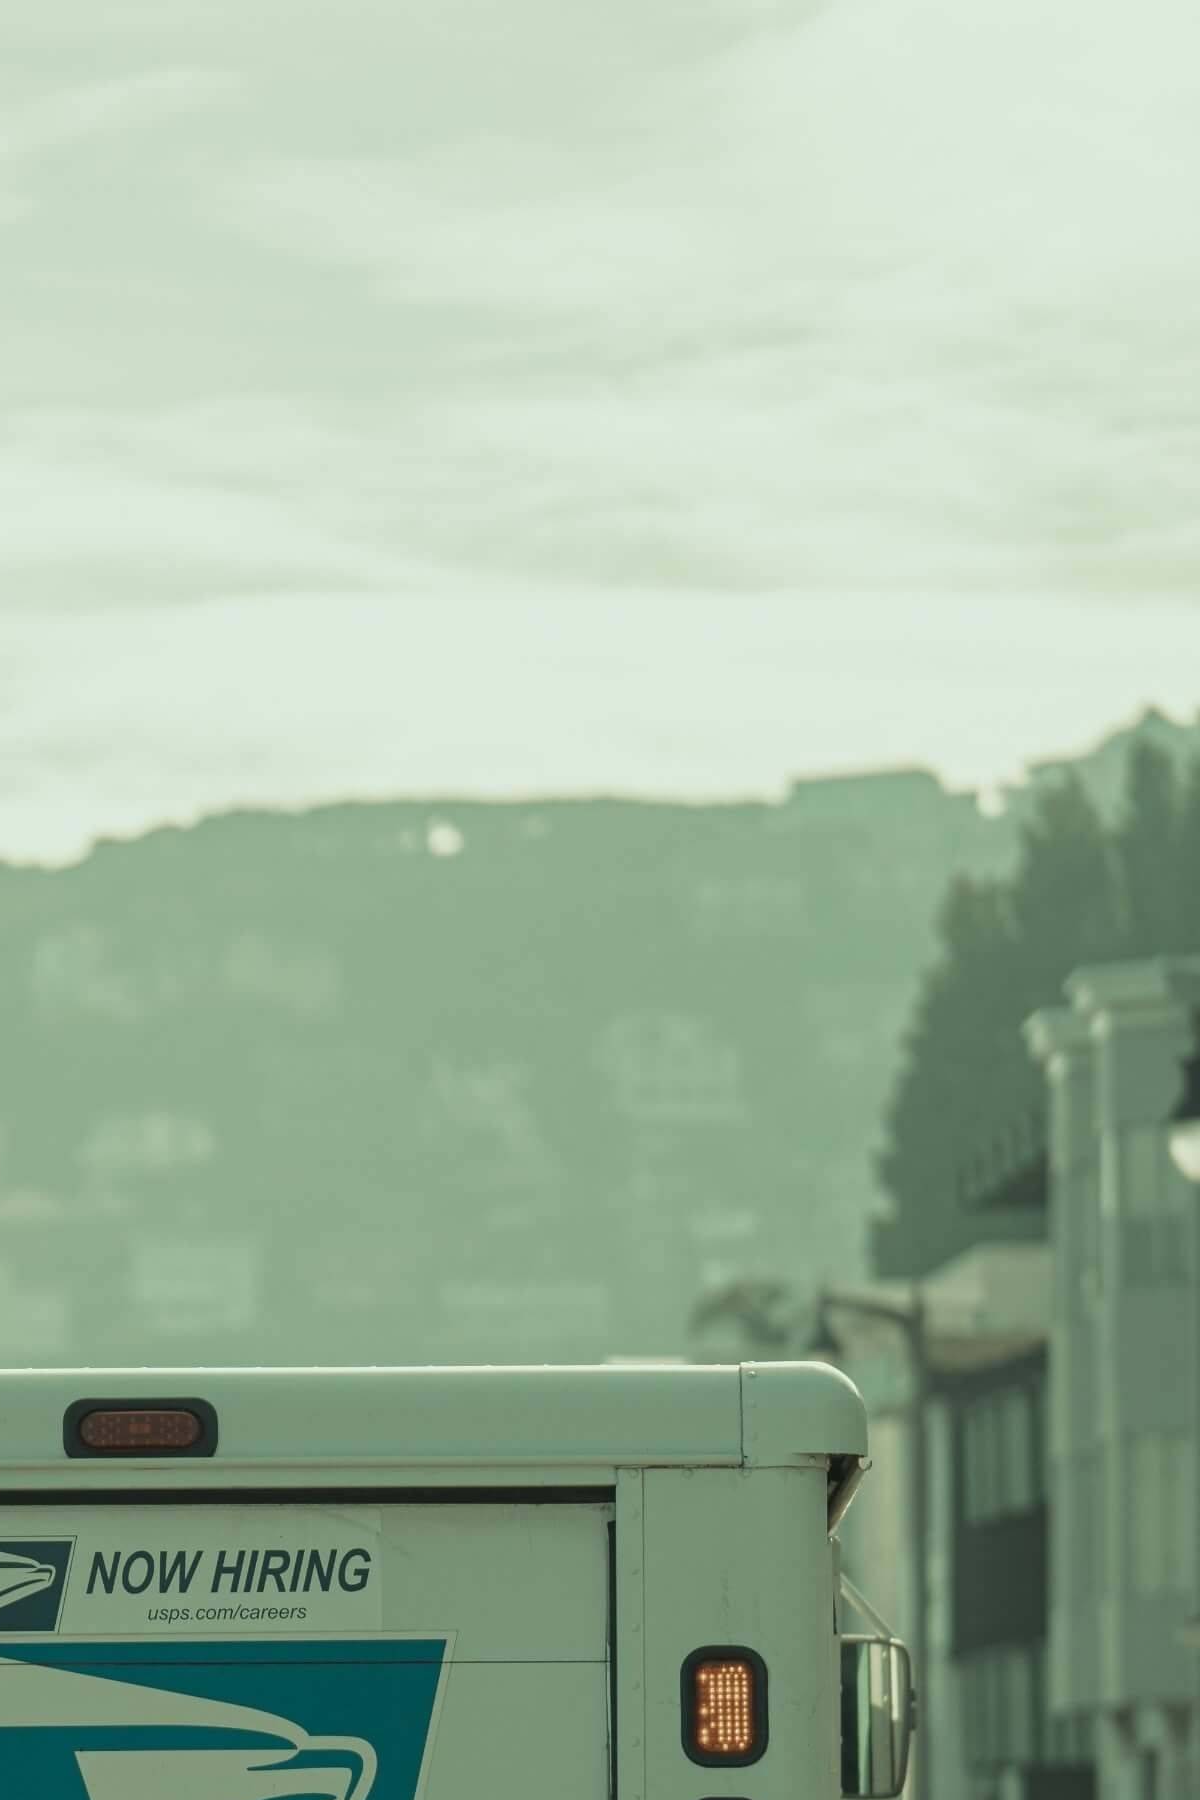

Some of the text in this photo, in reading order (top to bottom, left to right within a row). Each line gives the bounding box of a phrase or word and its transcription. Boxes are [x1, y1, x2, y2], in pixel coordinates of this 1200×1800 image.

[86, 1548, 372, 1594] NOW HIRING
[147, 1604, 307, 1624] usps.com/careers
